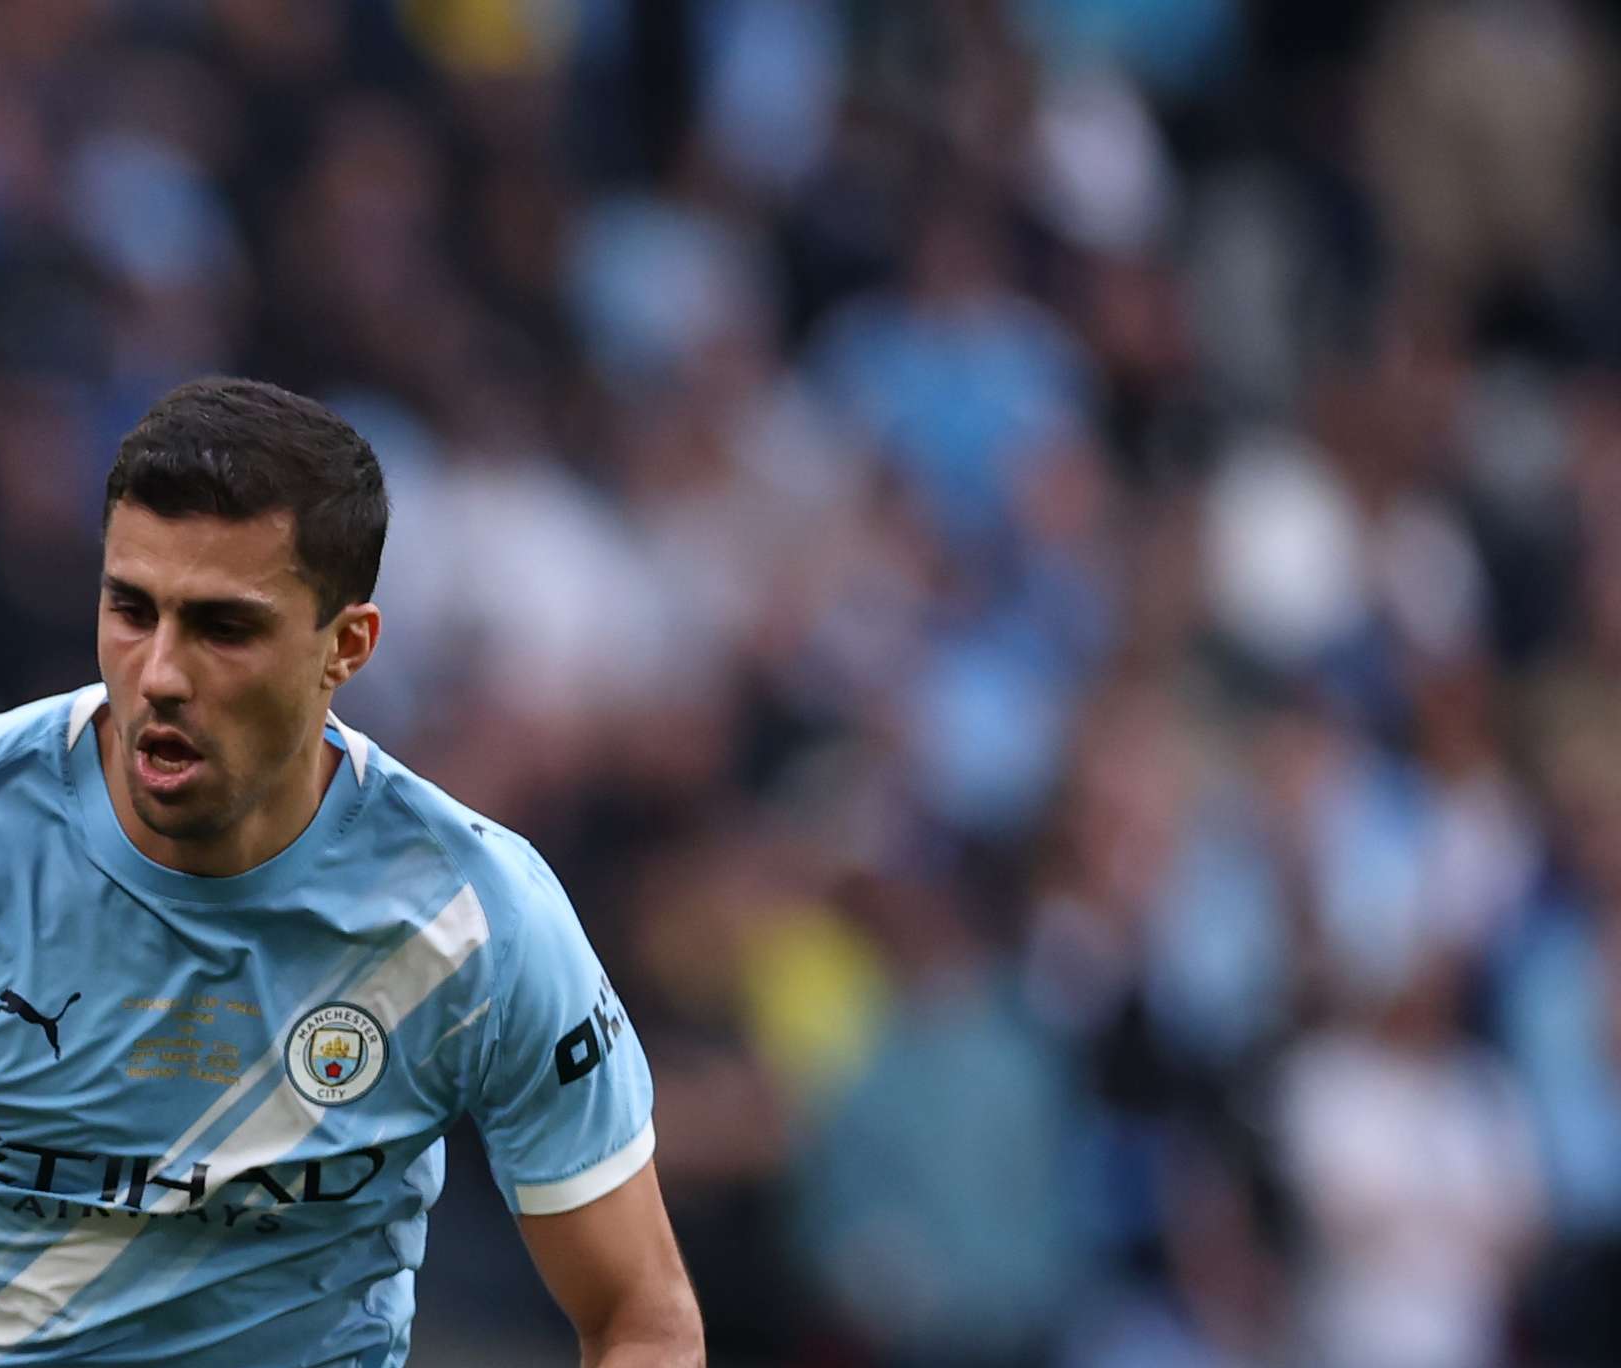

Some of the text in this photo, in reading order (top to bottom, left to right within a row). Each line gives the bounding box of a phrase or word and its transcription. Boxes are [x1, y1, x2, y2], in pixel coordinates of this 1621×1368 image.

[298, 1010, 378, 1044] MANCHESTER
[317, 1088, 346, 1099] CITY
[12, 1194, 283, 1234] AIAYS
